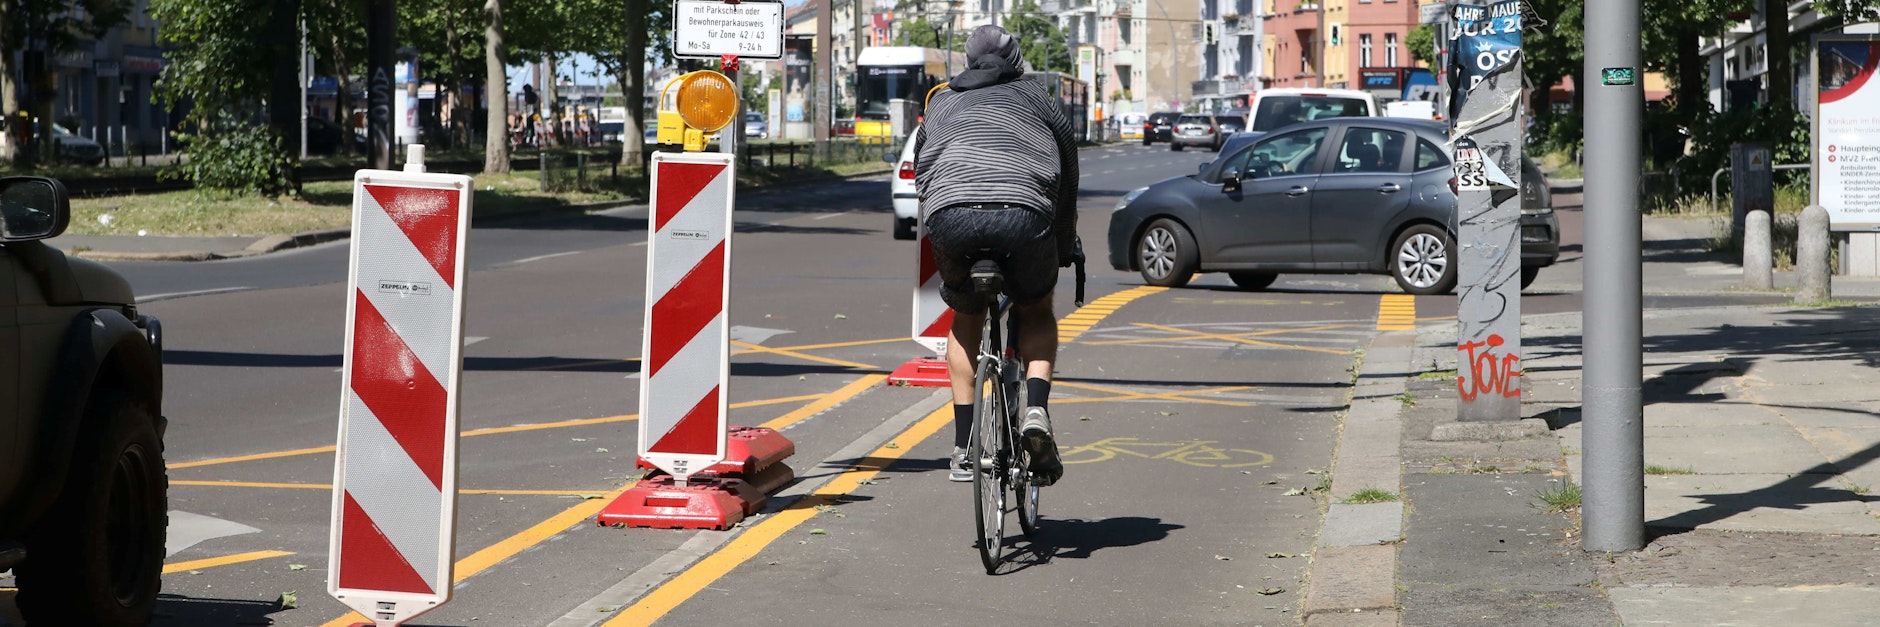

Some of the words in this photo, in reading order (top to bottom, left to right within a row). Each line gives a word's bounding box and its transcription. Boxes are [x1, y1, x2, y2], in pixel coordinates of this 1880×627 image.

[693, 6, 704, 14] mit
[706, 6, 744, 15] Parkschein
[745, 7, 760, 15] oder
[688, 17, 764, 28] Bewohnerparkausweis
[708, 30, 718, 38] für
[720, 30, 736, 39] Zone
[739, 31, 748, 39] 42
[756, 31, 765, 39] 43
[688, 41, 711, 49] Mo-Sa
[738, 42, 756, 51] 9-24
[757, 43, 762, 51] h
